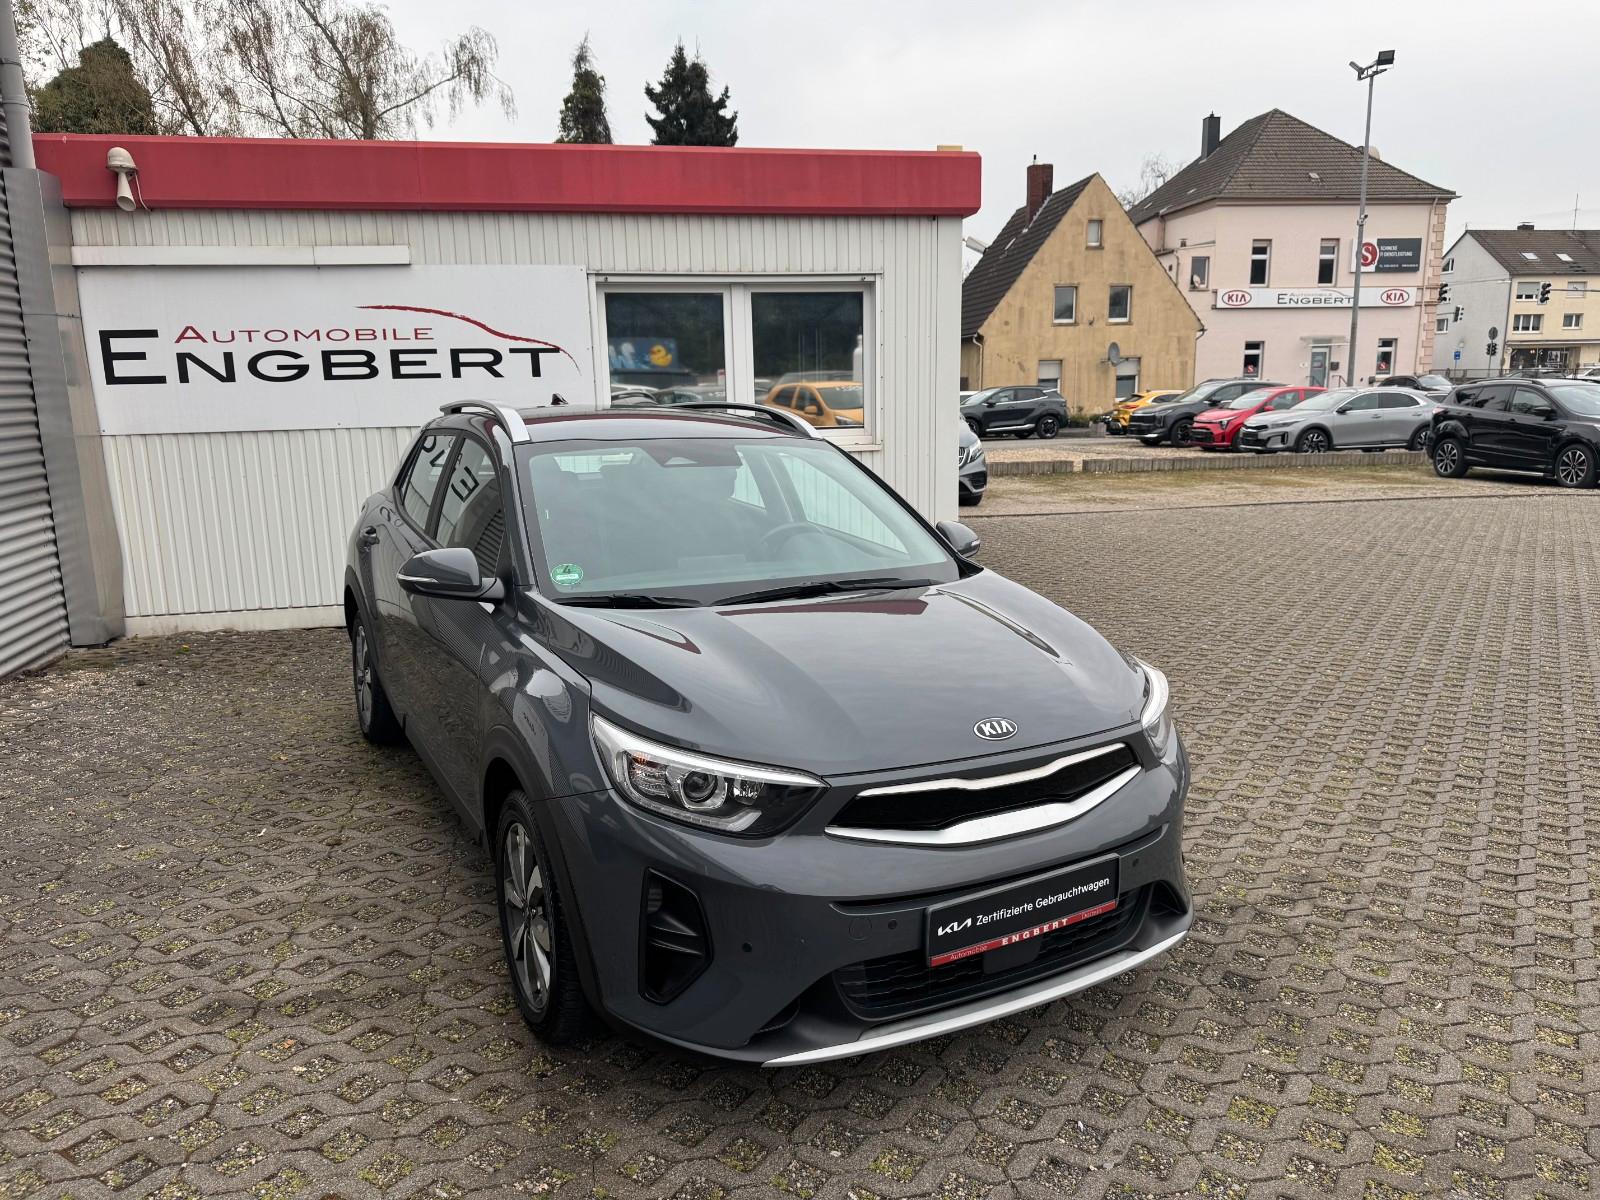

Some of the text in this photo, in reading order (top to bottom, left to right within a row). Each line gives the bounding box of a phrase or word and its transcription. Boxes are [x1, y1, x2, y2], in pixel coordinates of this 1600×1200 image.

[1227, 293, 1247, 303] KIA
[1277, 293, 1355, 305] ENGBERT
[1385, 292, 1405, 302] KIA
[174, 325, 434, 344] AUTOMOBILE
[99, 329, 561, 386] ENGBERT
[563, 565, 571, 574] 4
[980, 720, 1014, 736] KIA
[976, 901, 1034, 926] Zertifizierte
[1035, 878, 1110, 909] Gebrauchtwagen
[1001, 918, 1069, 946] ENGBERT
